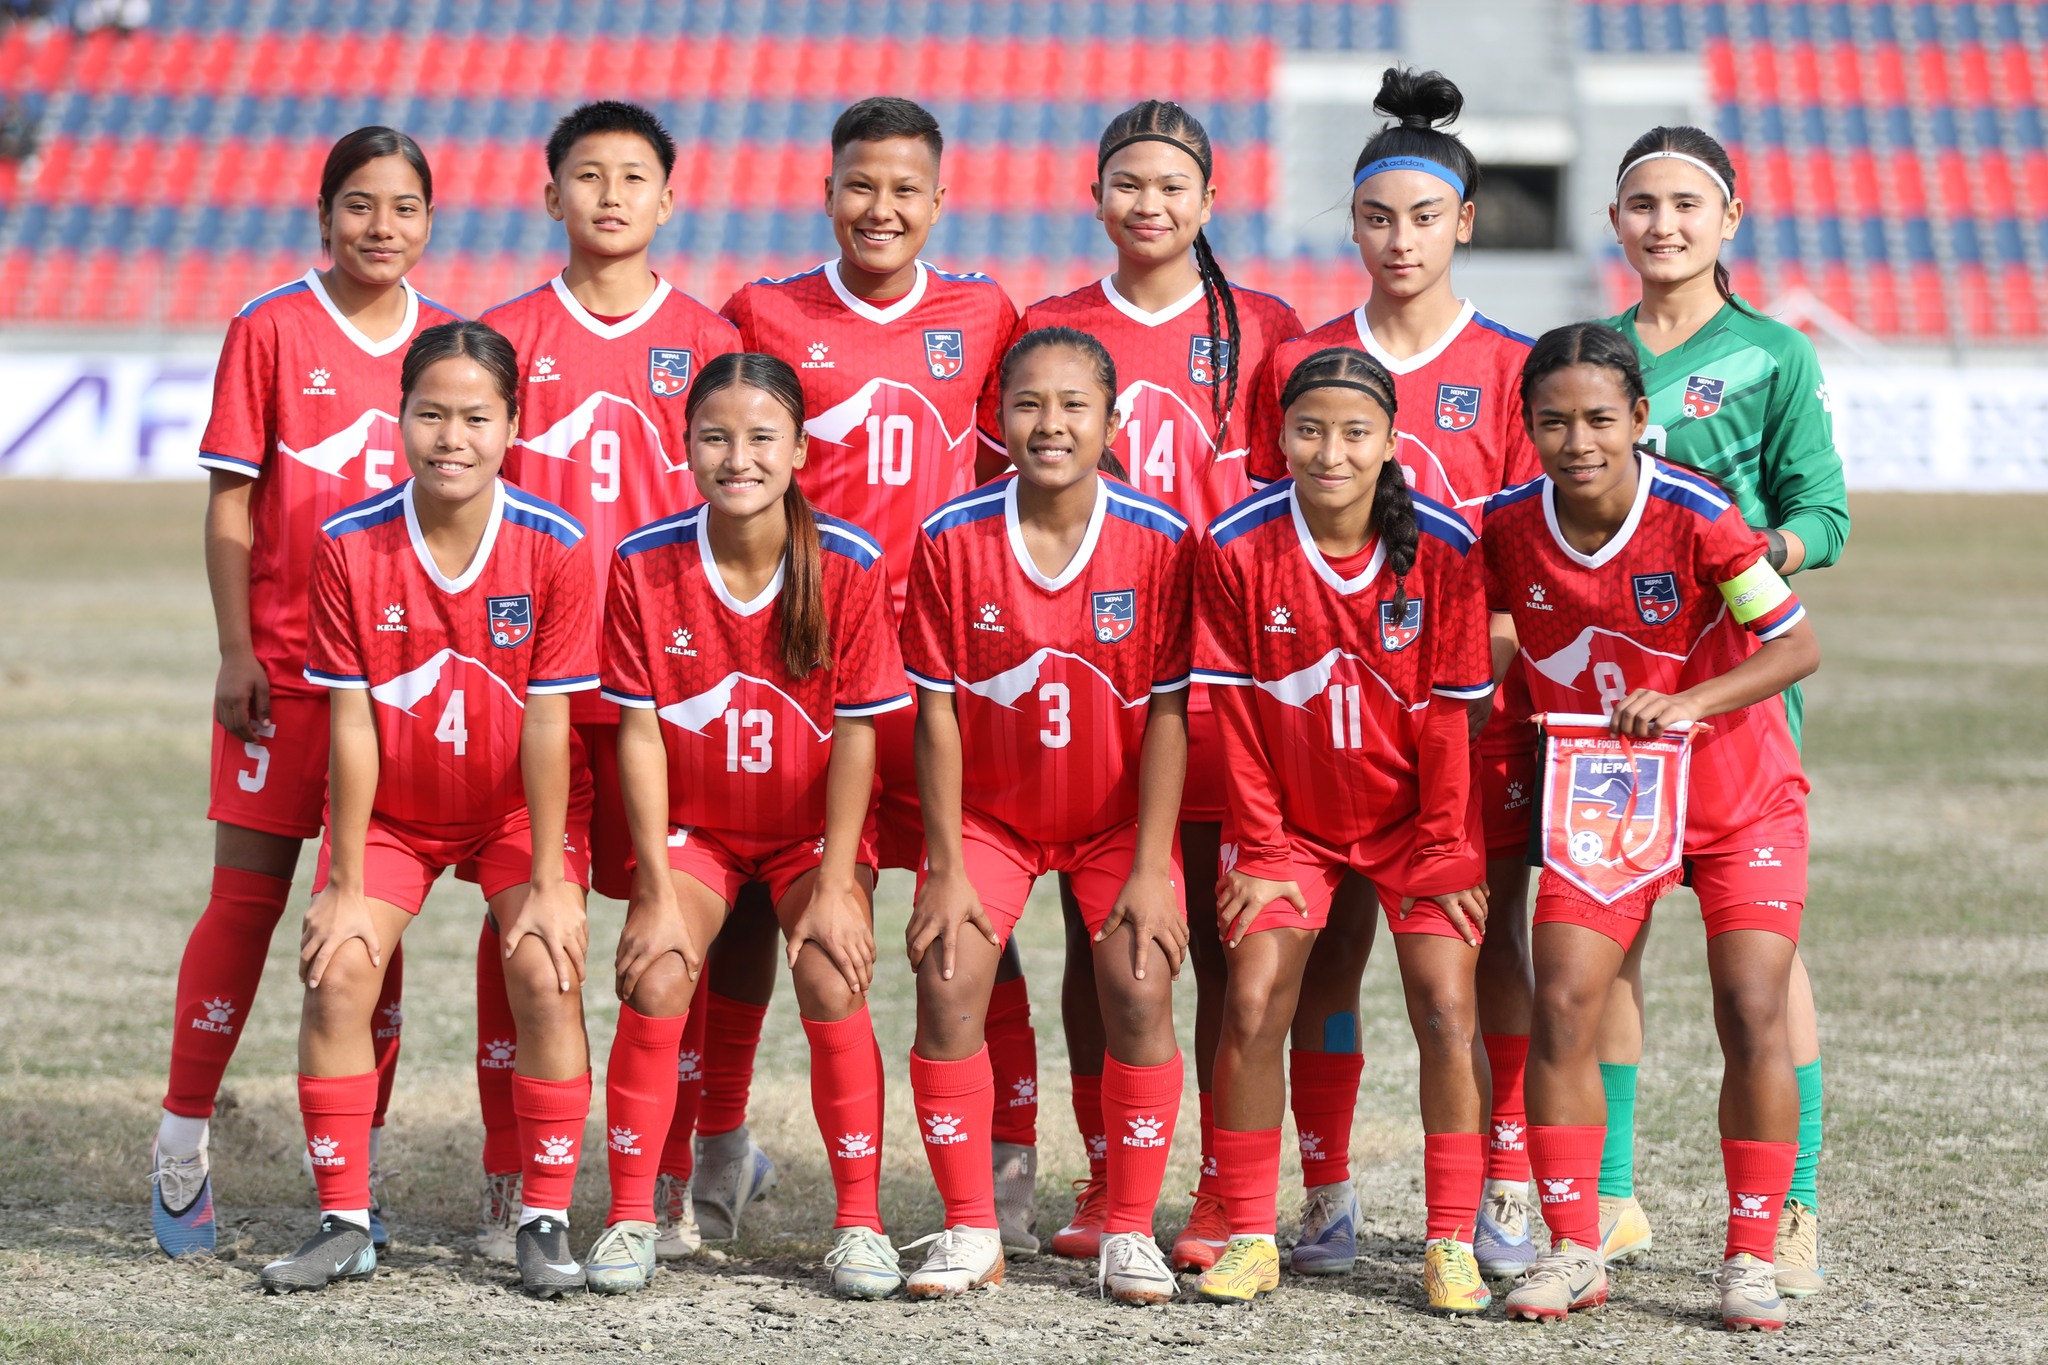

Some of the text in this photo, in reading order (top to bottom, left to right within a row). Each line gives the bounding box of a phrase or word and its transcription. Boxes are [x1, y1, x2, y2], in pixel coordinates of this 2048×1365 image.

[1389, 160, 1425, 168] adidas
[661, 352, 680, 360] NEPAL
[801, 361, 835, 369] KELME
[529, 373, 561, 383] KELME
[1696, 377, 1715, 387] NEPAL
[303, 387, 336, 396] KELME
[1450, 388, 1469, 397] NEPAL
[865, 414, 914, 486] 10
[1127, 419, 1176, 493] 14
[364, 448, 395, 490] 5
[590, 430, 621, 502] 9
[1644, 578, 1663, 586] NEPAL
[499, 600, 519, 608] NEPAL
[1104, 595, 1123, 603] NEPAL
[1526, 600, 1554, 612] KELME
[376, 623, 409, 633] KELME
[973, 622, 1005, 633] KELME
[1264, 624, 1297, 635] KELME
[664, 646, 698, 657] KELME
[1592, 661, 1629, 716] 8
[1038, 682, 1072, 749] 3
[1328, 683, 1363, 749] 11
[433, 689, 468, 756] 4
[724, 707, 774, 774] 13
[1560, 738, 1574, 747] ALL
[1574, 738, 1597, 748] NEPAL
[1632, 741, 1679, 752] ASSOCIATION
[236, 719, 277, 794] 5
[1504, 797, 1530, 811] KELME
[1749, 859, 1783, 868] KELME
[192, 1018, 233, 1035] KELME
[376, 1026, 401, 1039] KEL
[481, 1058, 516, 1069] KELM
[676, 1070, 702, 1082] ELME
[925, 1132, 969, 1145] KELME
[1122, 1135, 1166, 1148] KELME
[608, 1141, 642, 1156] KELME
[1490, 1140, 1524, 1151] KELME
[837, 1146, 877, 1159] KELME
[533, 1153, 575, 1165] KELME
[1542, 1191, 1581, 1203] KELME
[1732, 1207, 1770, 1219] KELME
